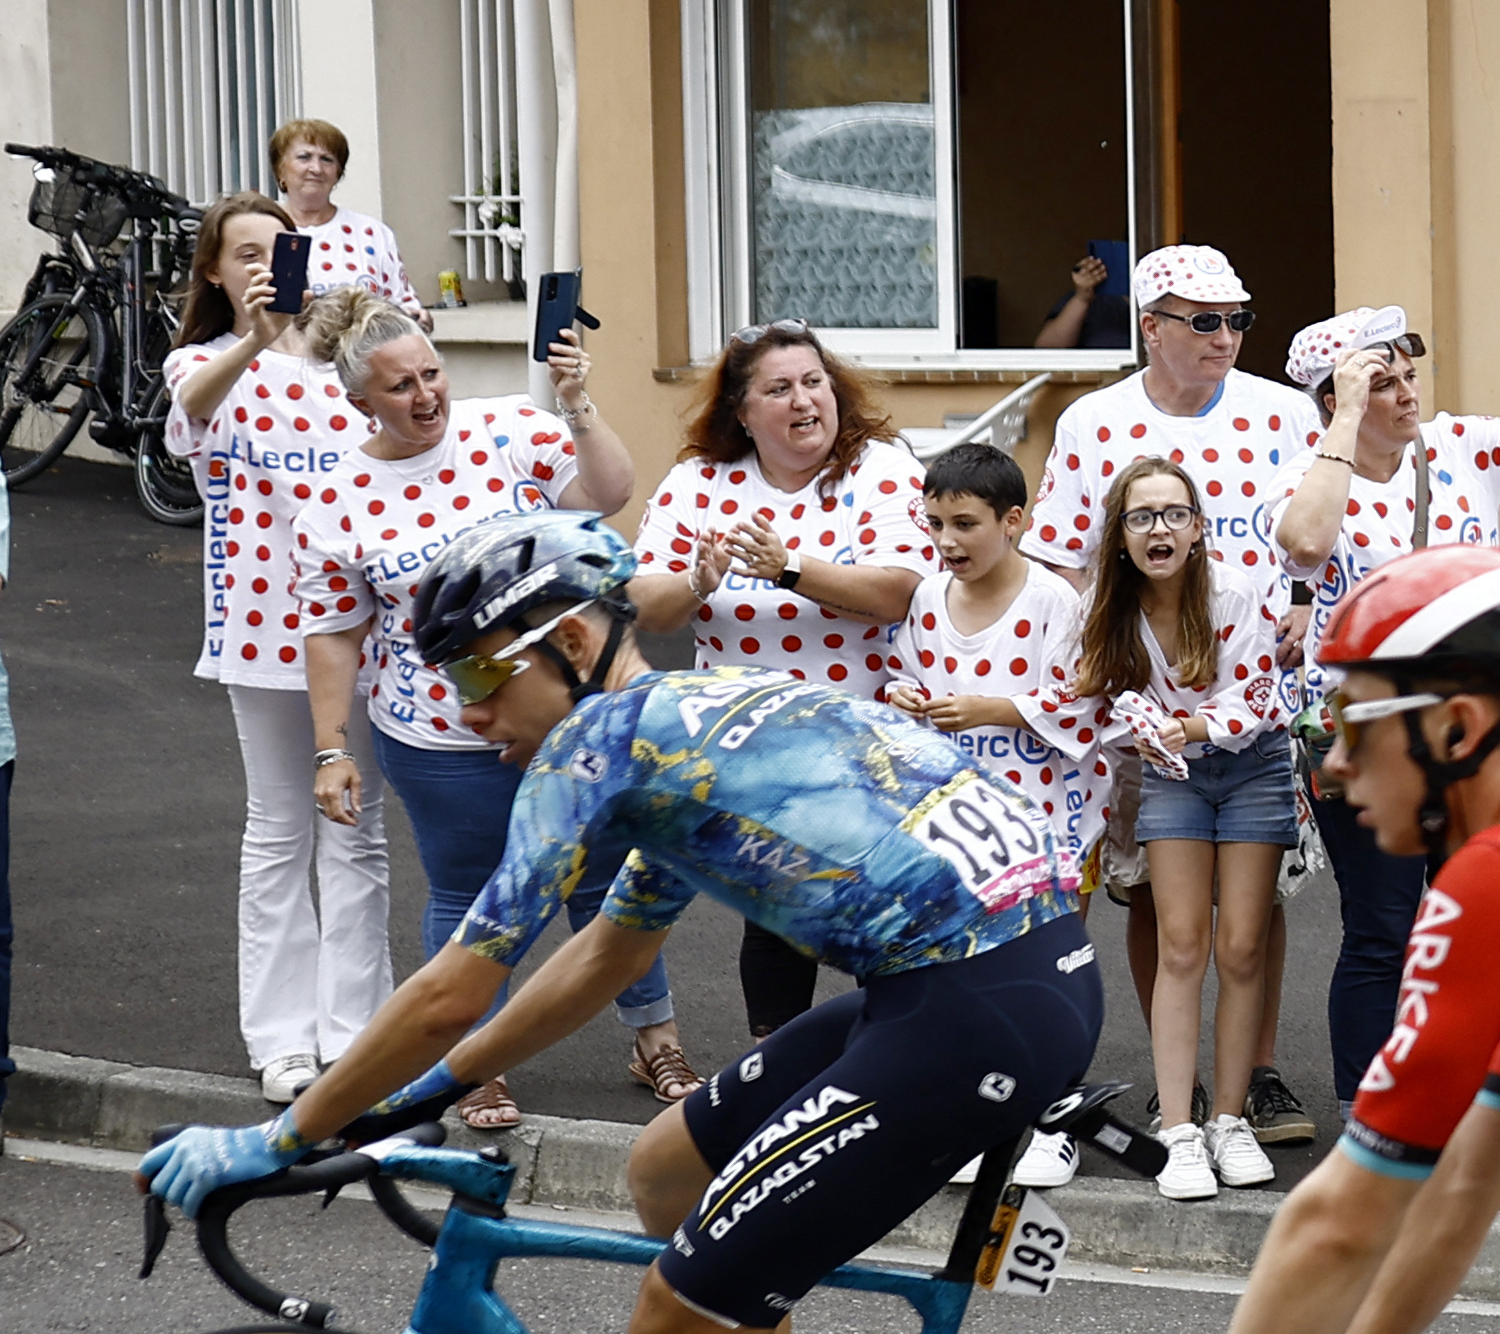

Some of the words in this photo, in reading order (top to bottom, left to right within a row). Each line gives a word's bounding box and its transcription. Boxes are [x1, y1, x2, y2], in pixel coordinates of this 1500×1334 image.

[738, 835, 809, 880] KAZ
[928, 785, 1039, 886] 193
[1360, 889, 1463, 1093] ARKEA
[700, 1084, 860, 1216] ASTANA
[706, 1113, 881, 1241] QAZAQSTAN
